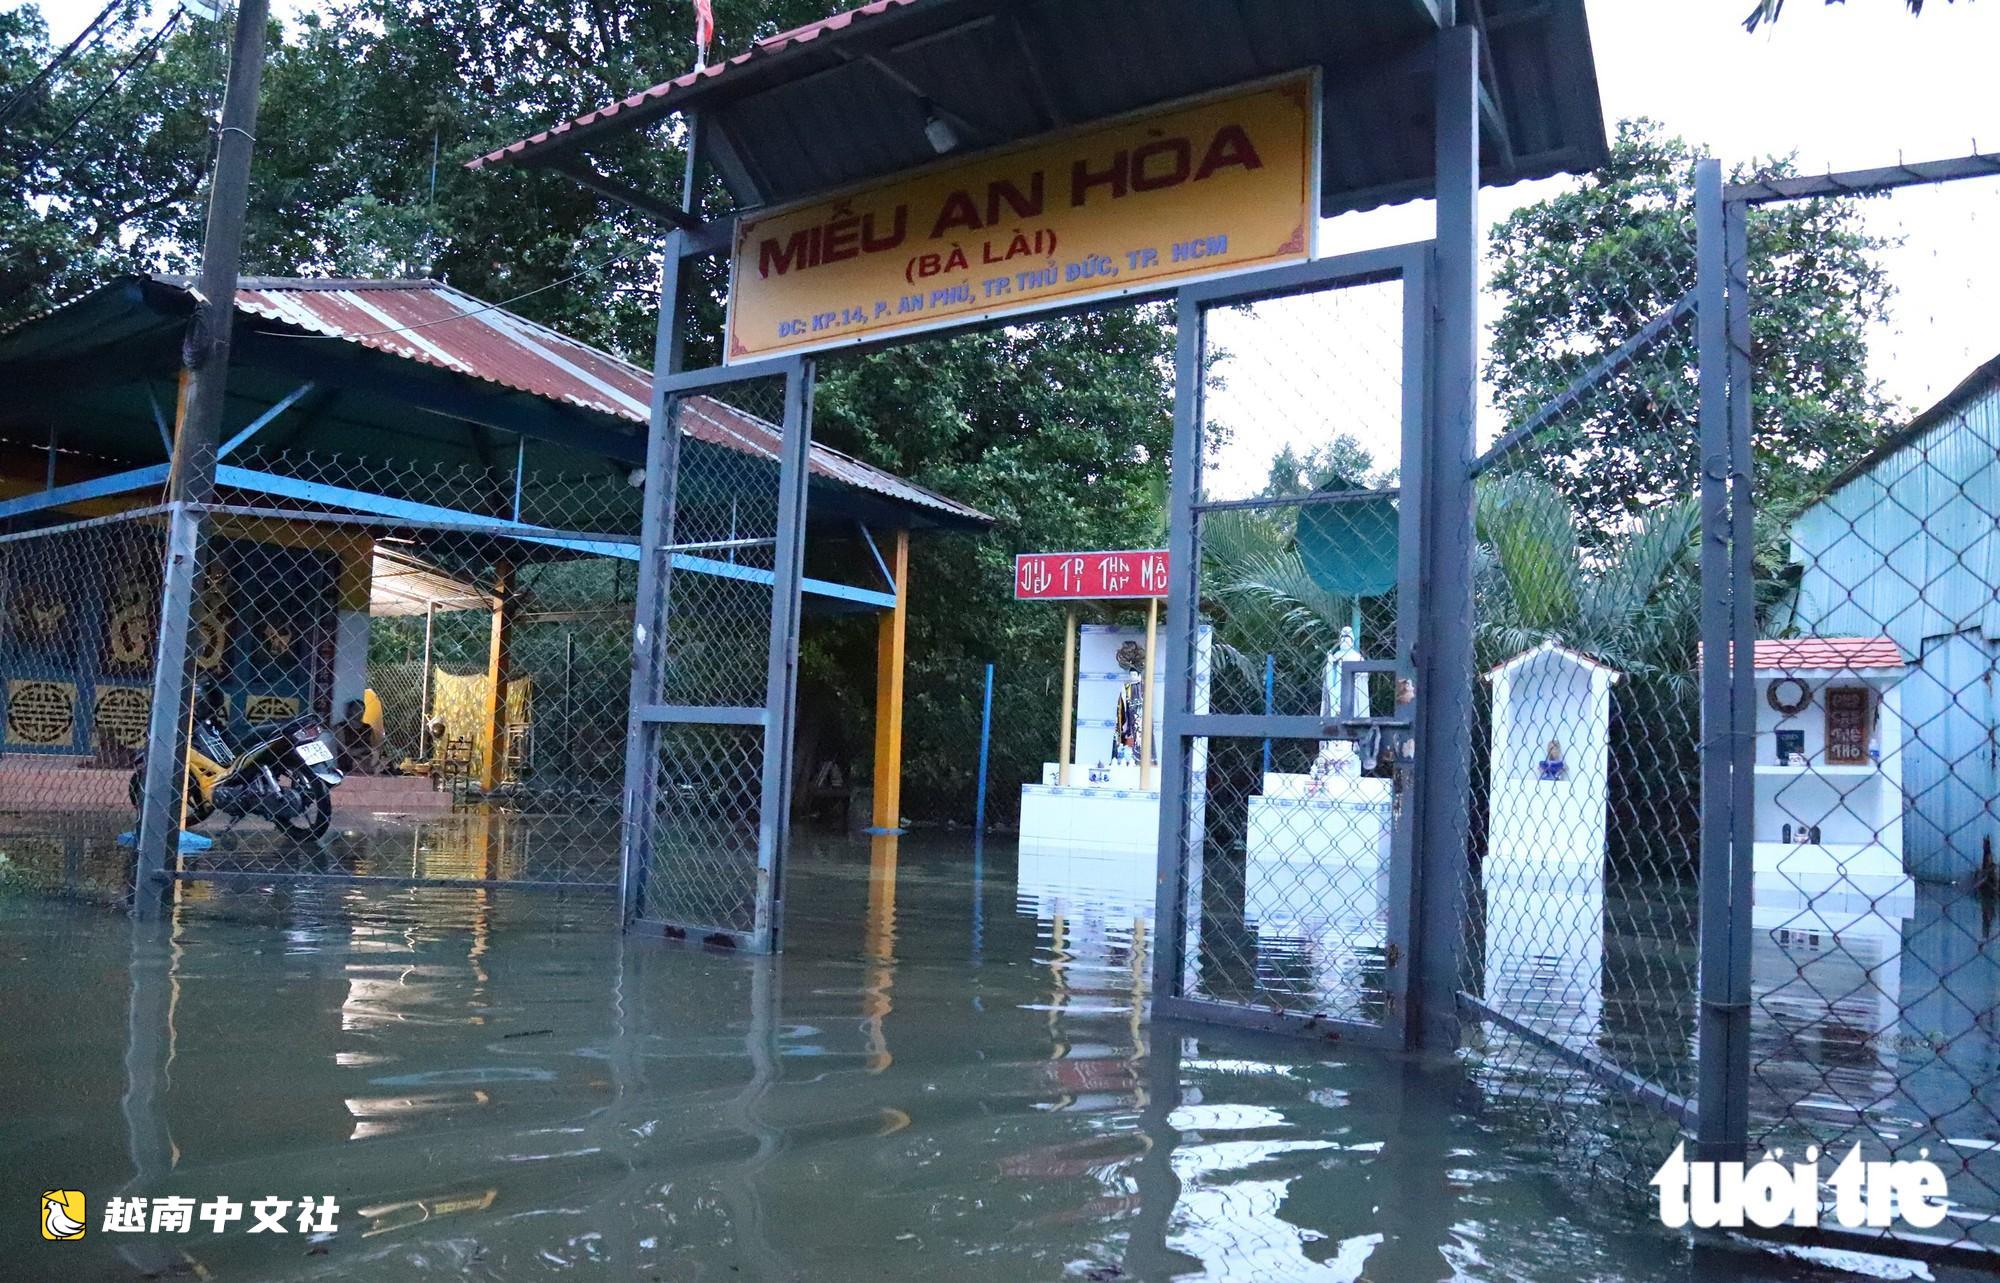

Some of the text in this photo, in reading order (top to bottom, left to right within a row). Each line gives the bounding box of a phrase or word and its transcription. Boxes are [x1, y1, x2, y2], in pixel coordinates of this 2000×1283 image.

[927, 171, 1044, 239] AN
[1070, 124, 1264, 207] HÒA
[778, 319, 807, 338] ĐC:
[874, 301, 891, 320] P.
[897, 293, 924, 314] AN
[929, 279, 976, 308] PHÚ,
[982, 276, 1012, 298] TP.
[1015, 259, 1059, 292] THỦ
[1064, 253, 1119, 283] ĐỨC,
[1125, 247, 1160, 271] TP.
[1171, 234, 1229, 263] HCM
[904, 243, 969, 285] (BÀ
